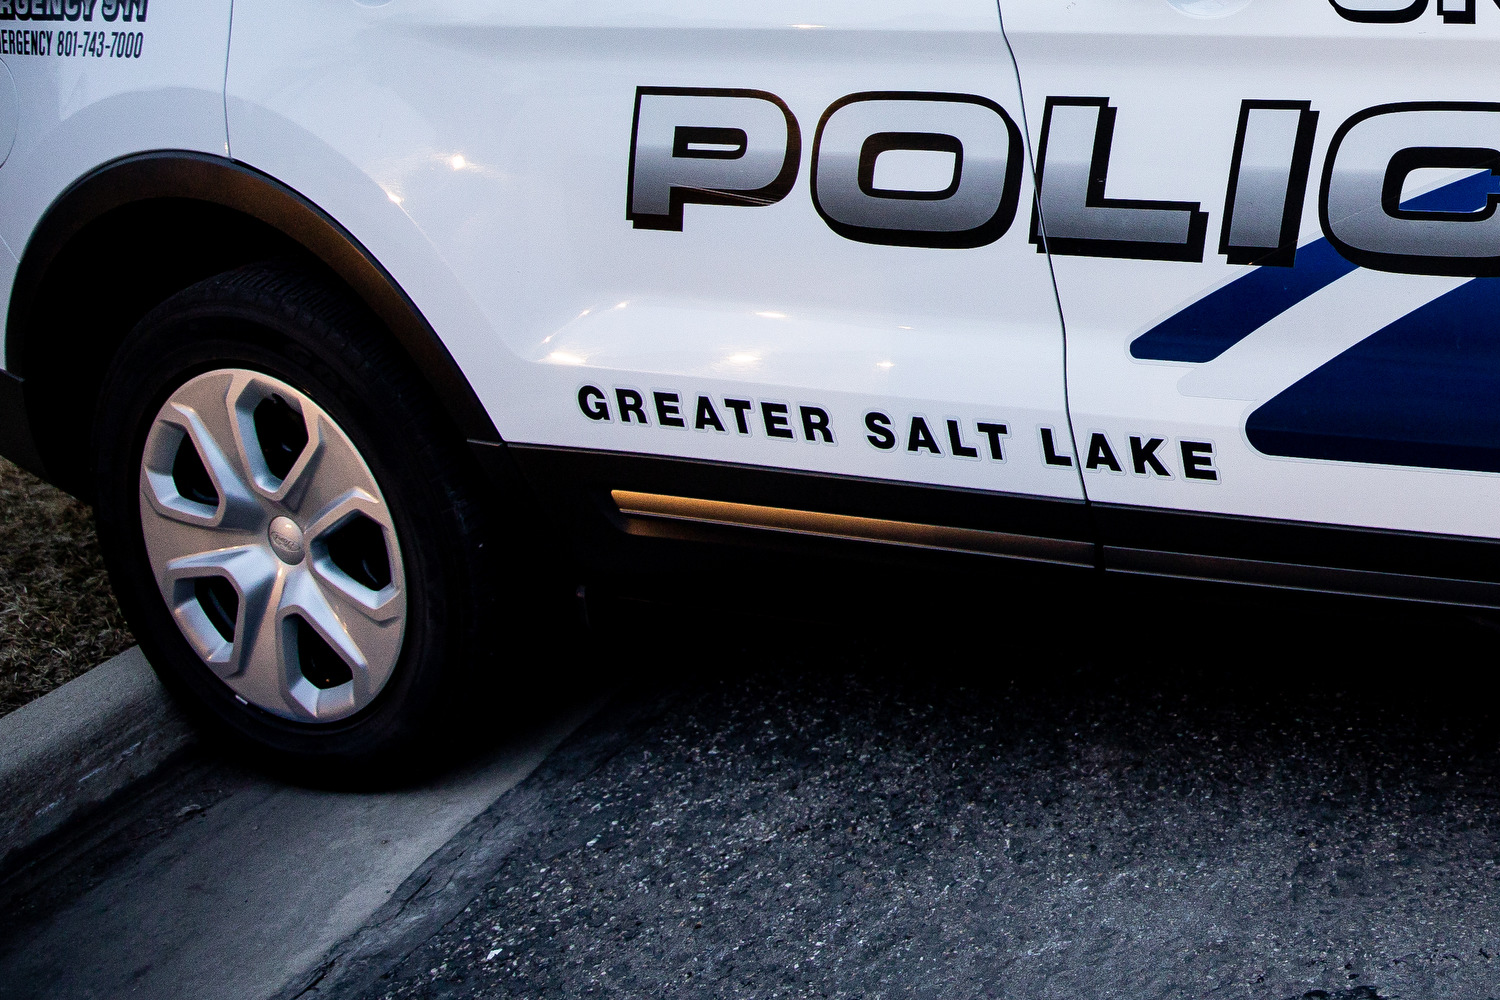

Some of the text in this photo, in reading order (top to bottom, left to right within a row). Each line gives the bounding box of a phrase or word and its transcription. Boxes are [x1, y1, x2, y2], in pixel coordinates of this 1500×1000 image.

[0, 29, 144, 58] ERGENCY 801-743-7000
[577, 384, 1218, 482] GREATER SALT LAKE
